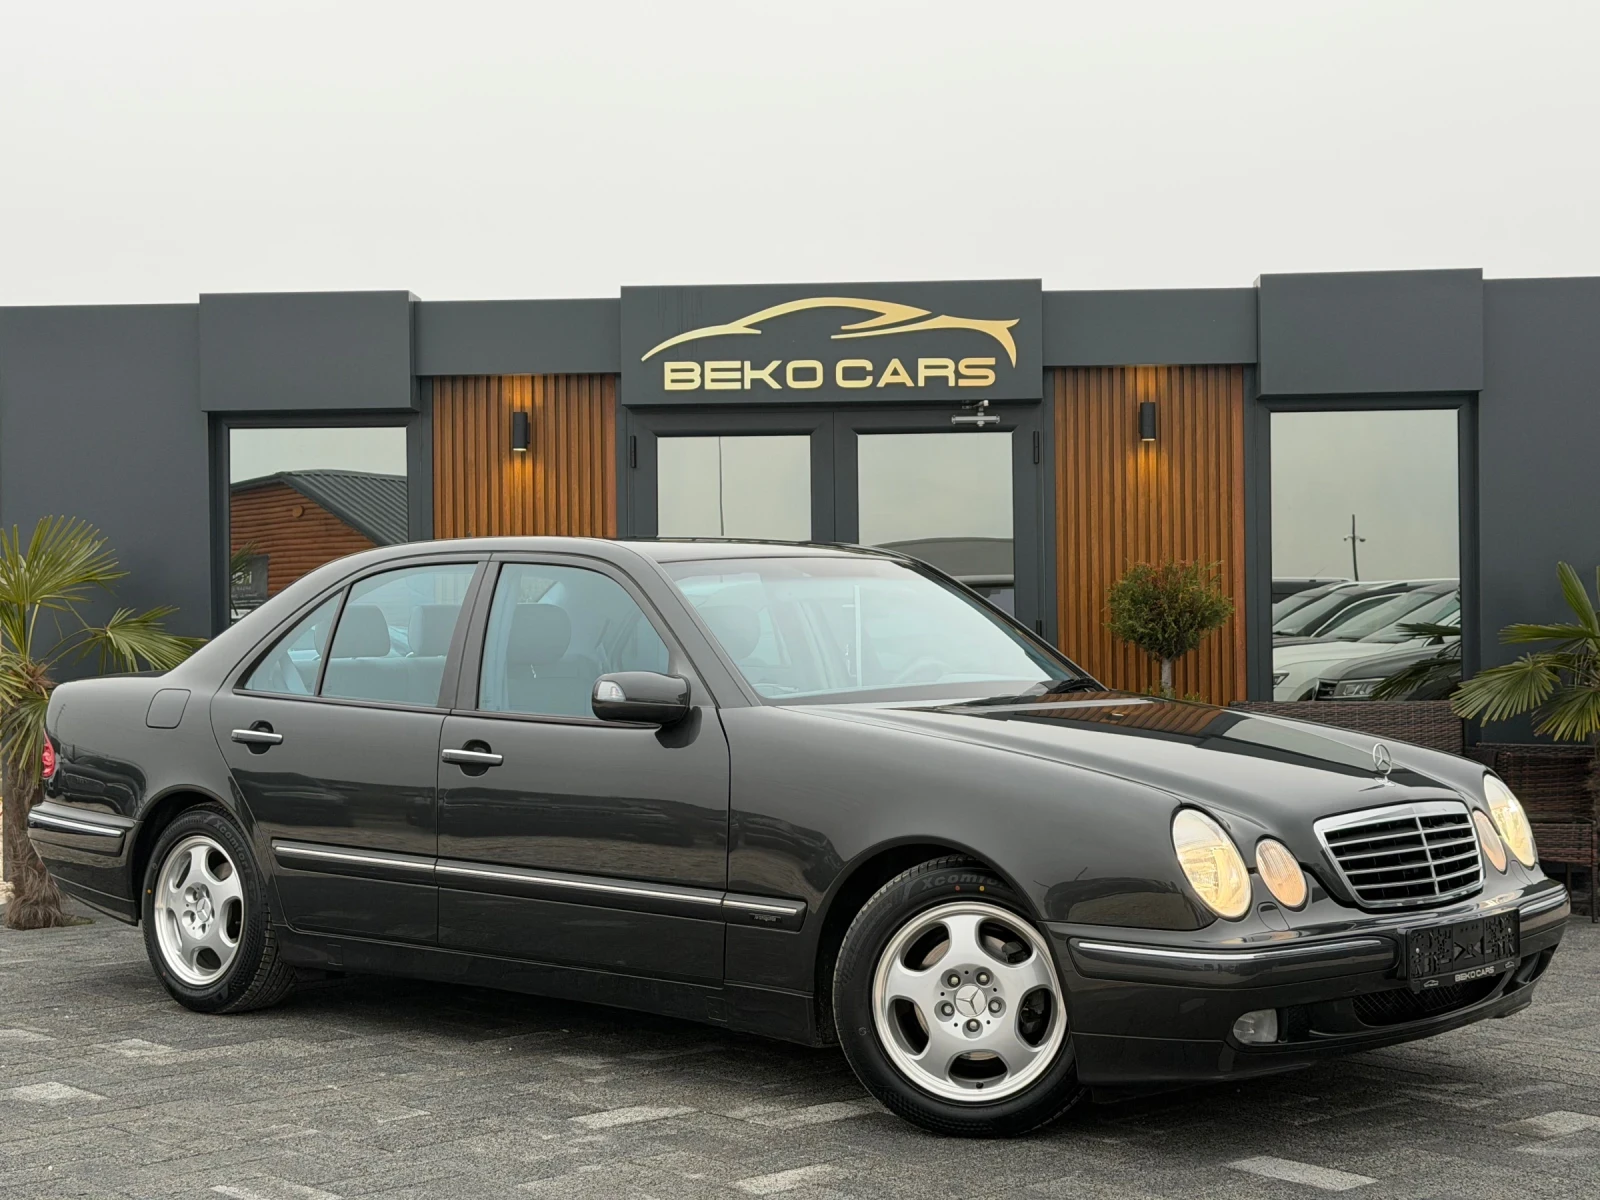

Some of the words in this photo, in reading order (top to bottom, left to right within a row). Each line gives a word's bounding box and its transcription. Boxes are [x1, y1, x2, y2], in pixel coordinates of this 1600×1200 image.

[664, 359, 824, 391] BEKO
[835, 357, 997, 389] CARS
[214, 820, 252, 873] Xcomfort
[1455, 971, 1475, 982] BEKO
[1476, 966, 1495, 977] CARS
